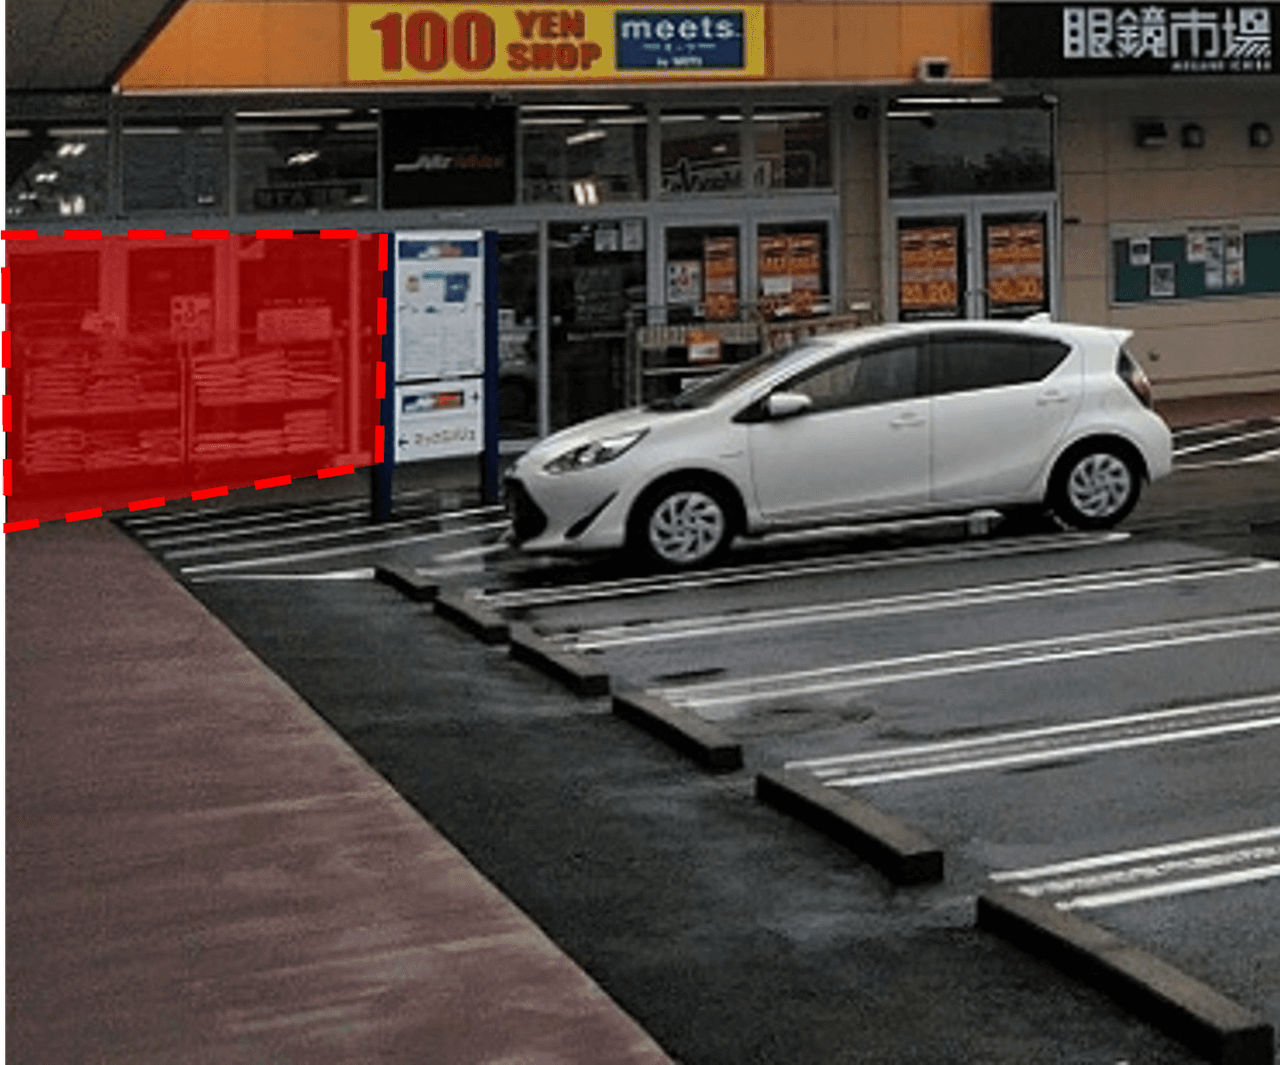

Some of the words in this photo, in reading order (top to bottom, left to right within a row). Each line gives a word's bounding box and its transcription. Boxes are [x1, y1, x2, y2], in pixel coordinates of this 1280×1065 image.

[370, 11, 497, 72] 100
[514, 9, 587, 38] YEN
[506, 42, 603, 72] SHOP
[1062, 6, 1272, 59] 眼鏡市場
